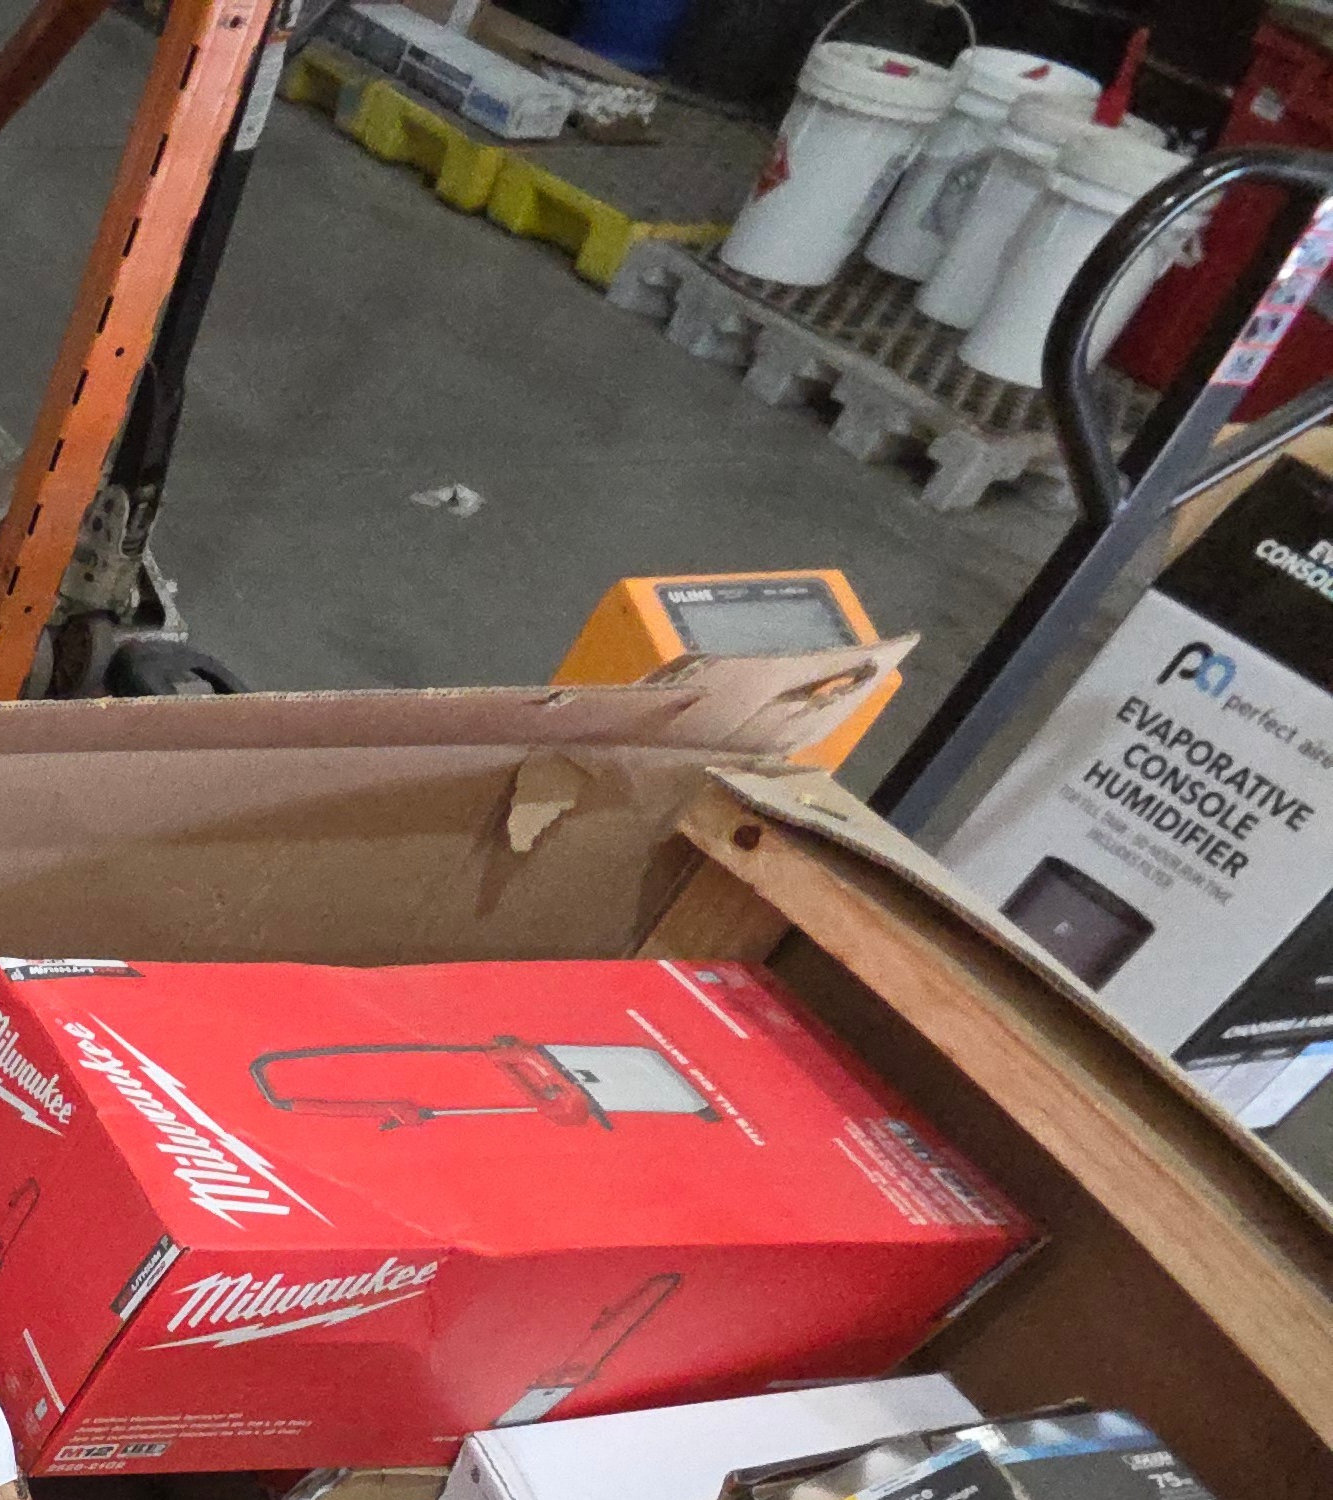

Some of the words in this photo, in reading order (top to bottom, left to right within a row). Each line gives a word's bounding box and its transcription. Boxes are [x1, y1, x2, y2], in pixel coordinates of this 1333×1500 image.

[1083, 759, 1249, 878] HUMIDIFIER
[1116, 695, 1314, 832] EVAPORATIVE
[1123, 742, 1259, 841] CONSOLE
[61, 1020, 292, 1229] Milwaukee
[154, 1256, 439, 1332] Milwaukee
